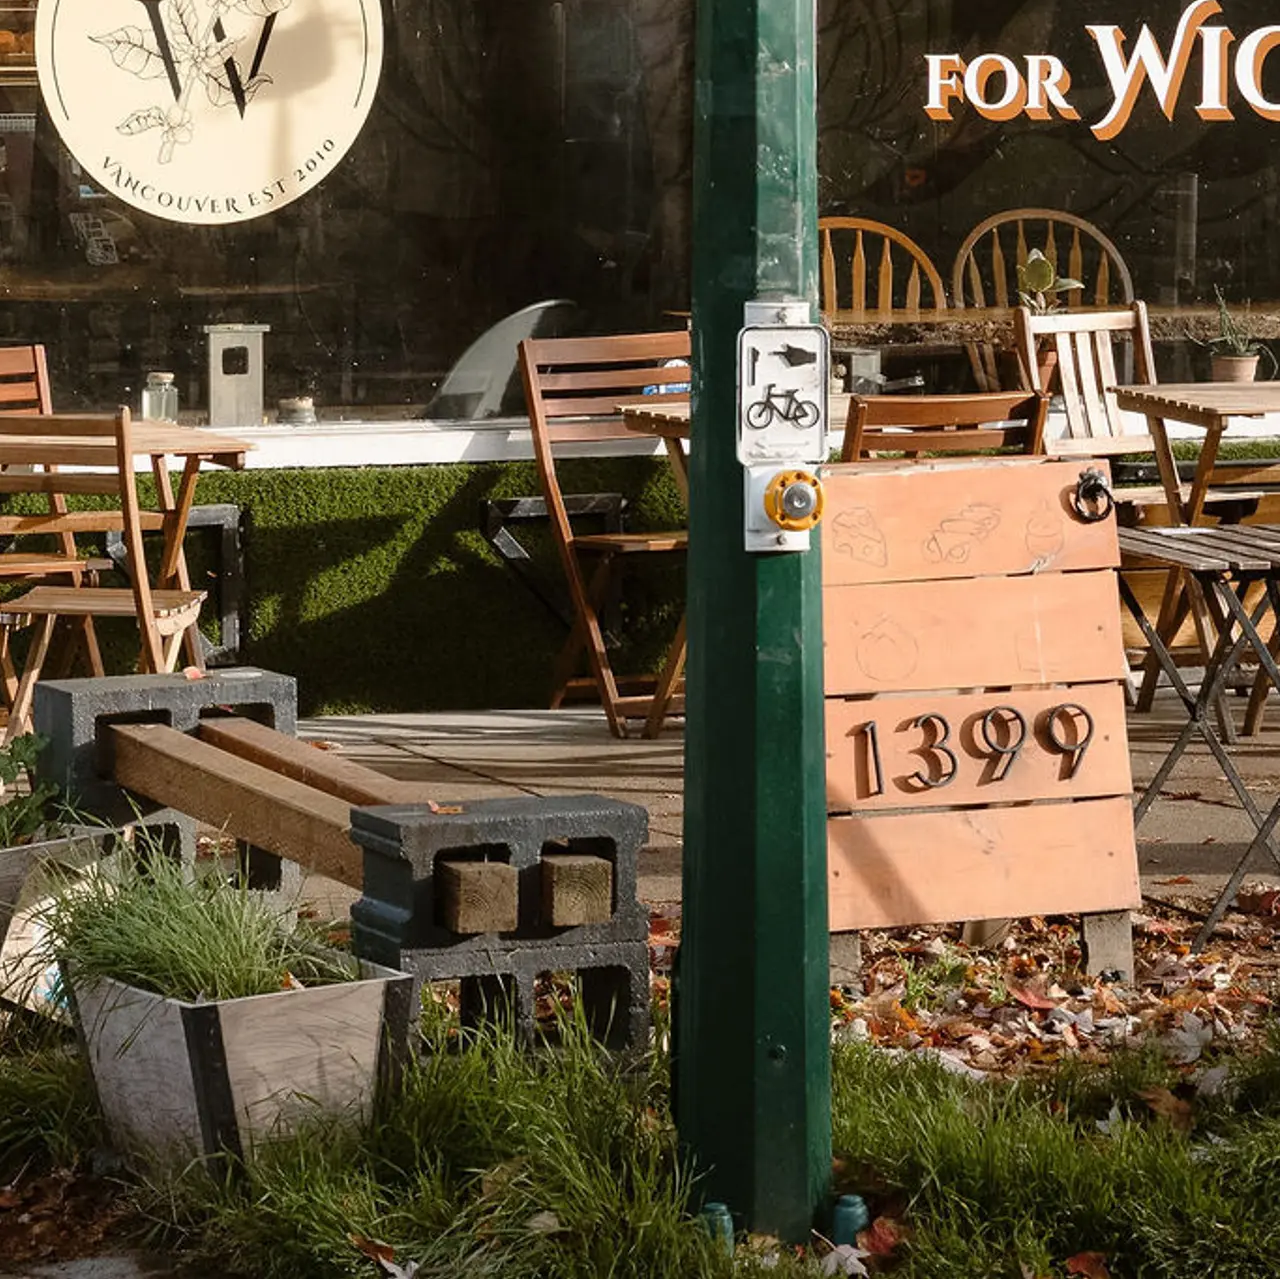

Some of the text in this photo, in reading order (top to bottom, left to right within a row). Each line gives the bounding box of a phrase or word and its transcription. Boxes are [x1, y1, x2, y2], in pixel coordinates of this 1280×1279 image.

[922, 52, 1083, 122] FOR
[102, 138, 337, 215] VANCOUVER EST 2010
[860, 703, 1095, 797] 1399
